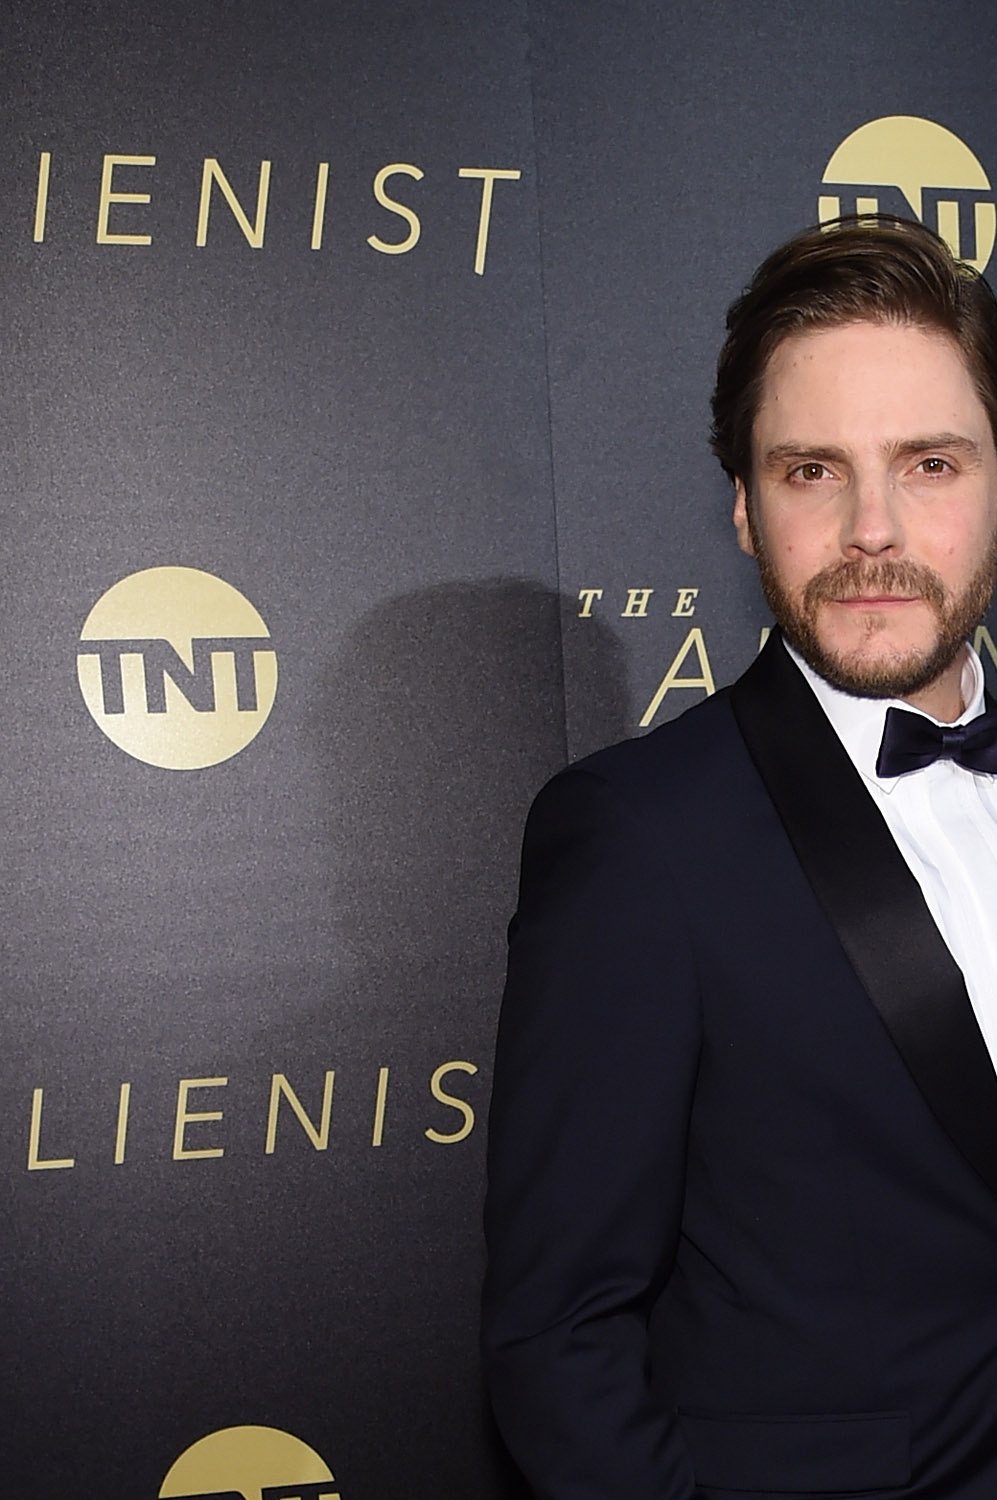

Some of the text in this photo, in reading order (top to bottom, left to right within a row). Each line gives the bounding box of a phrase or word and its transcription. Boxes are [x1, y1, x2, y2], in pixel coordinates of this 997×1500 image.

[579, 588, 698, 617] THE
[78, 637, 276, 715] TNT
[27, 1061, 478, 1171] LIENIS
